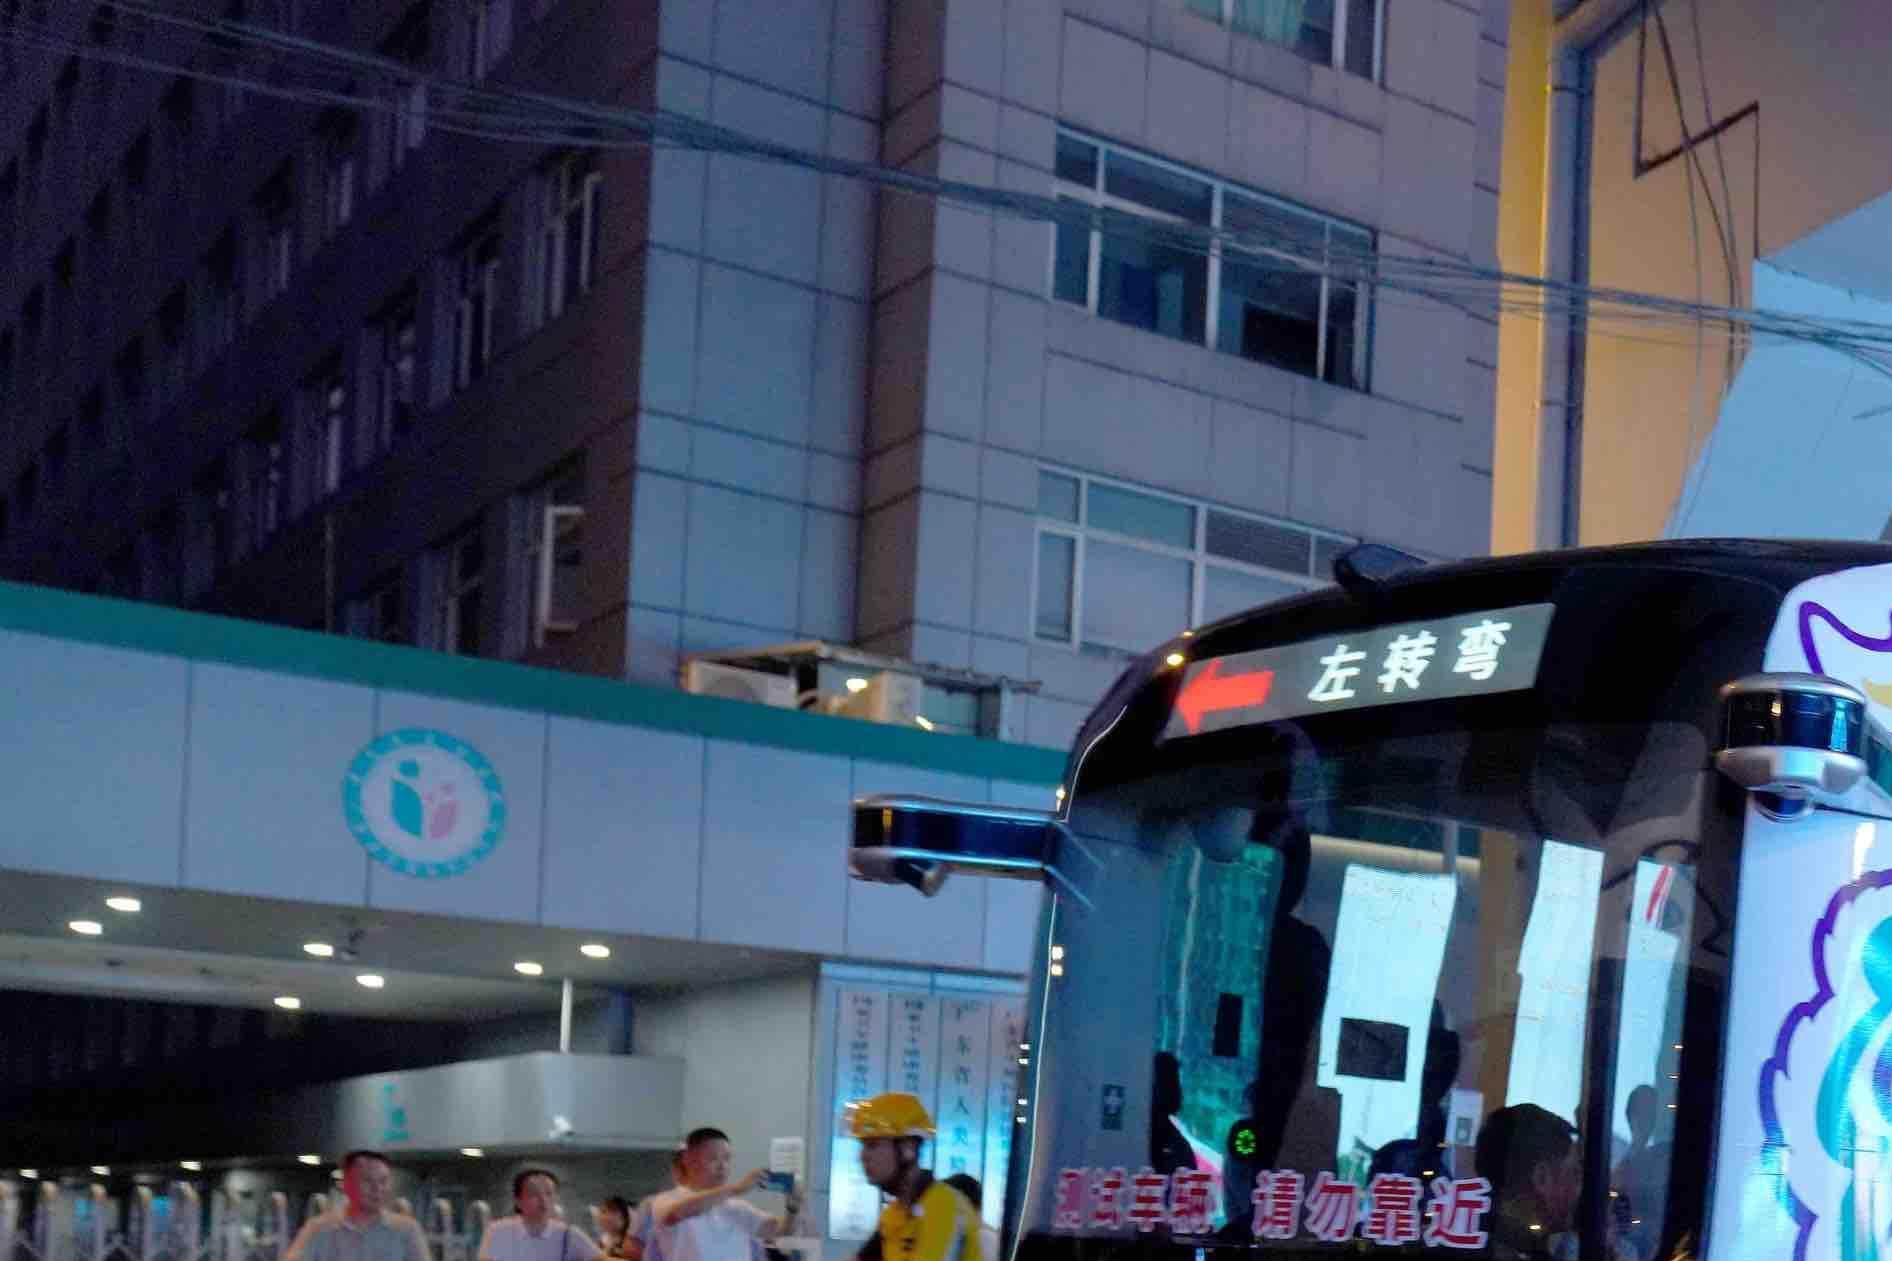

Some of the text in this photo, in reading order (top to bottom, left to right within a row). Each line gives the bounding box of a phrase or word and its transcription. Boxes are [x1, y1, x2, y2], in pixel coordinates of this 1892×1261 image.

[1308, 619, 1511, 701] 左转弯
[1055, 1166, 1493, 1249] 测试车辆 请勿靠近
